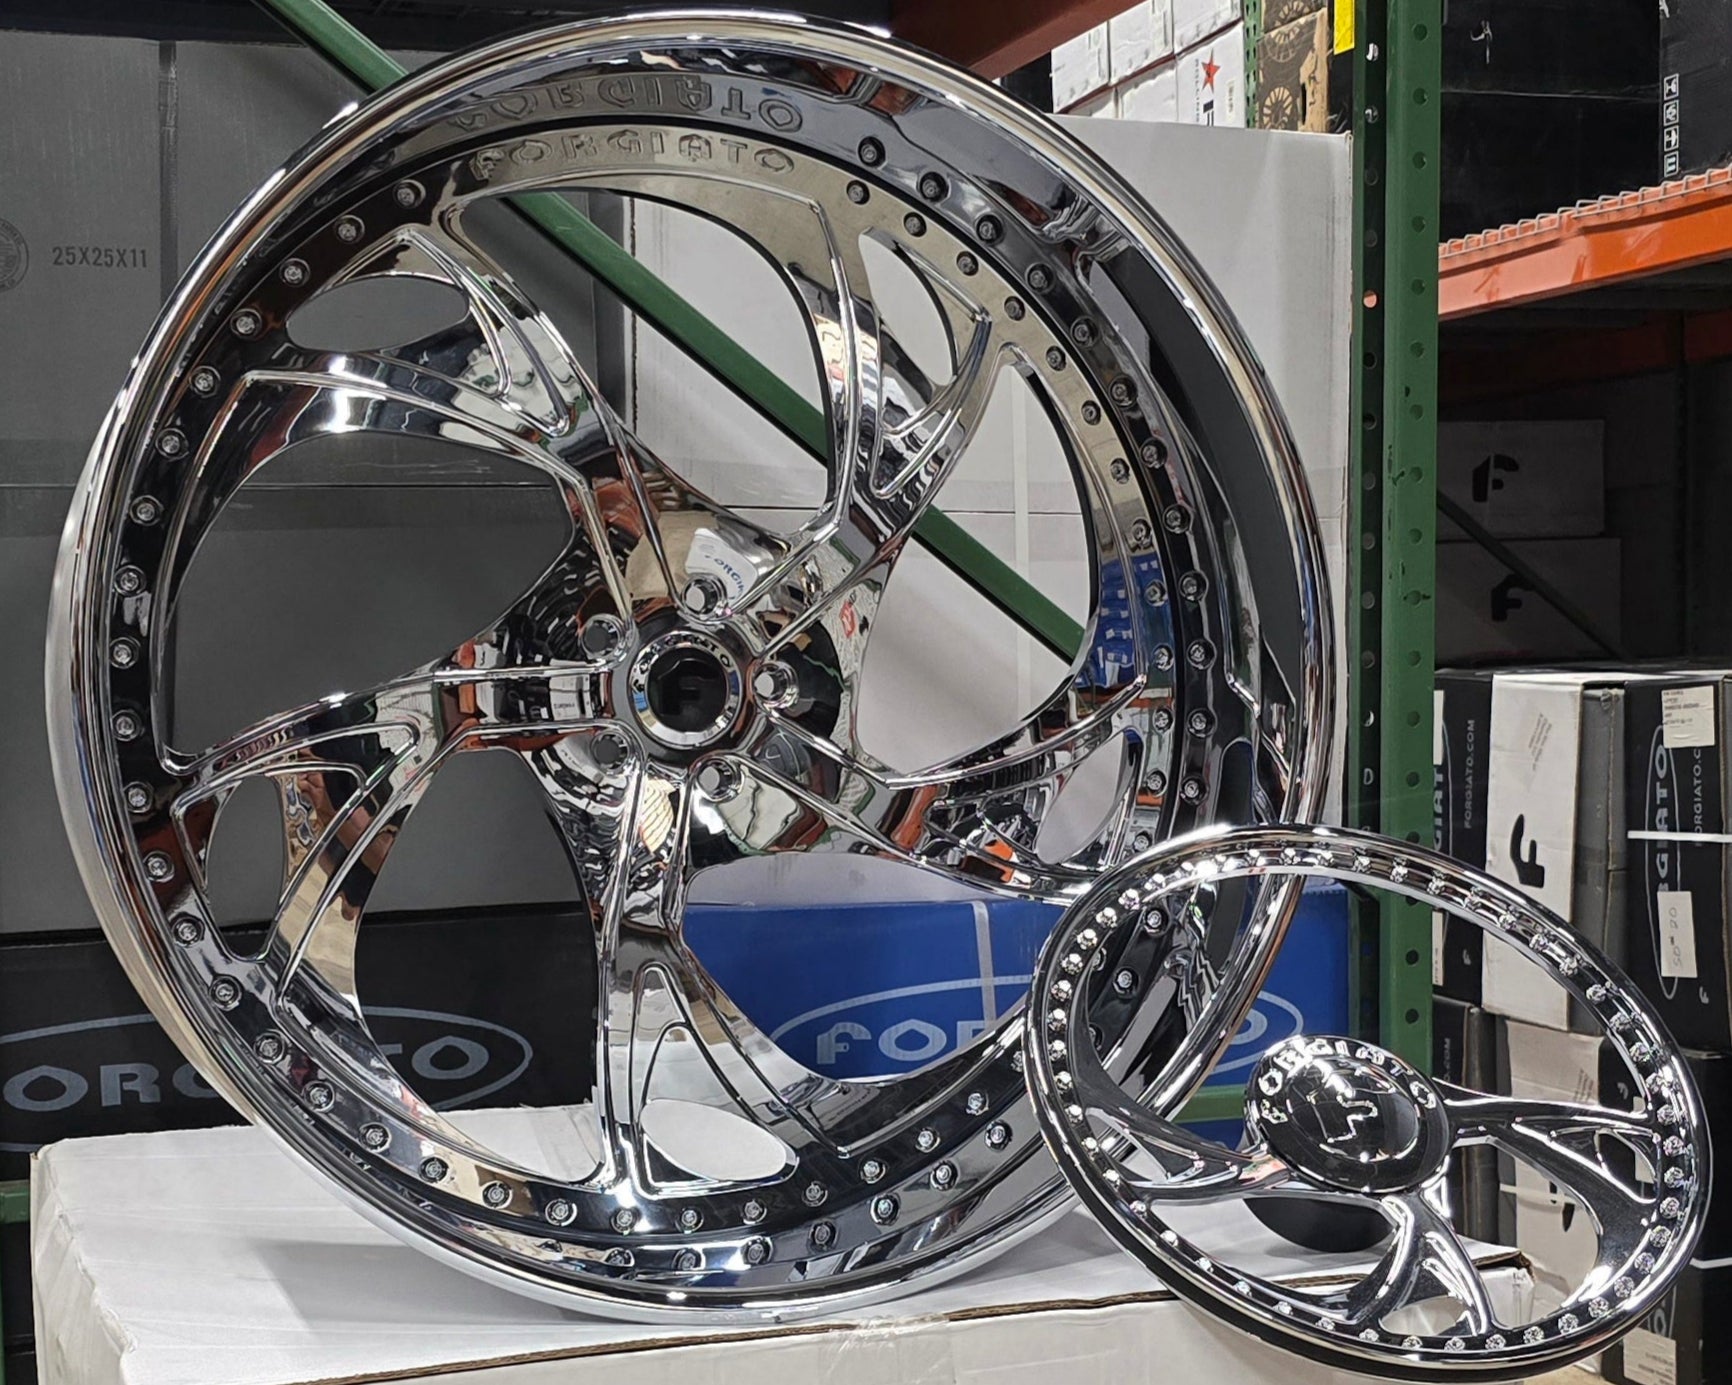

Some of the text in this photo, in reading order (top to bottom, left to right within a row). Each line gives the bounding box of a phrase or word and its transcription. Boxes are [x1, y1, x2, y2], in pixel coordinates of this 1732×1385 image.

[469, 129, 795, 180] FORGIATO
[51, 245, 148, 269] 25X25X11
[1463, 719, 1475, 829] FORGIATO.COM
